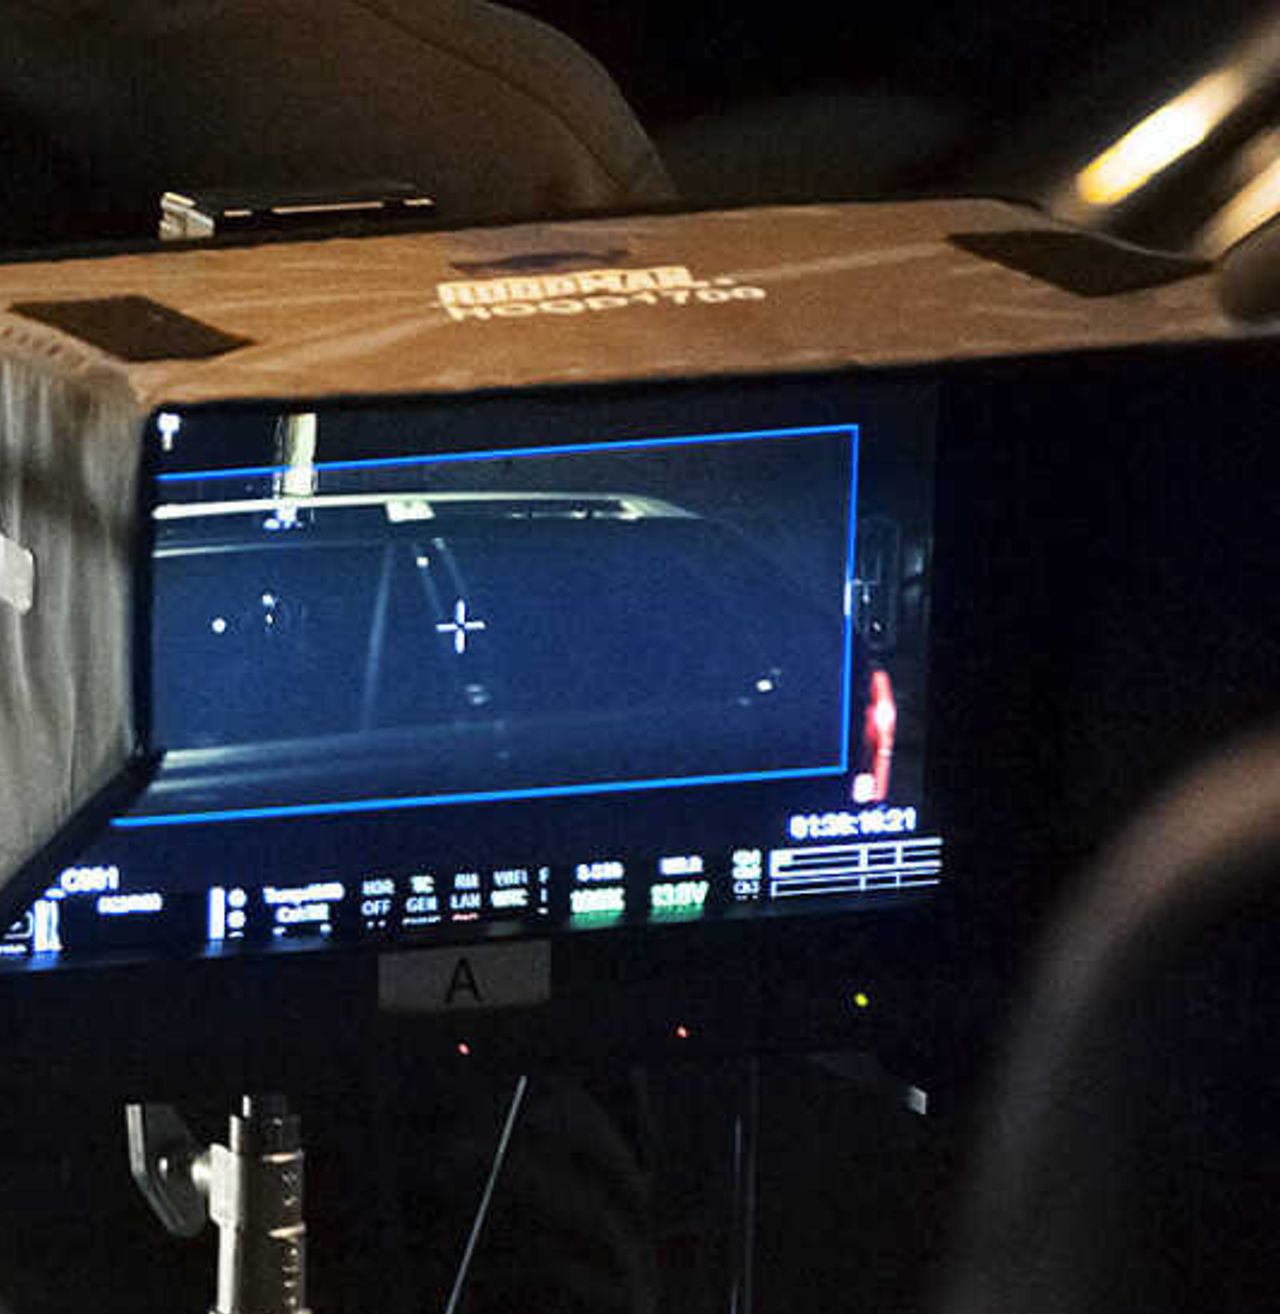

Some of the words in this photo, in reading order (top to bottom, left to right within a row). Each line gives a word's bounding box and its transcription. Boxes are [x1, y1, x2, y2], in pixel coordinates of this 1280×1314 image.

[361, 899, 391, 916] OFF
[405, 896, 438, 912] GEN
[443, 957, 483, 1003] A
